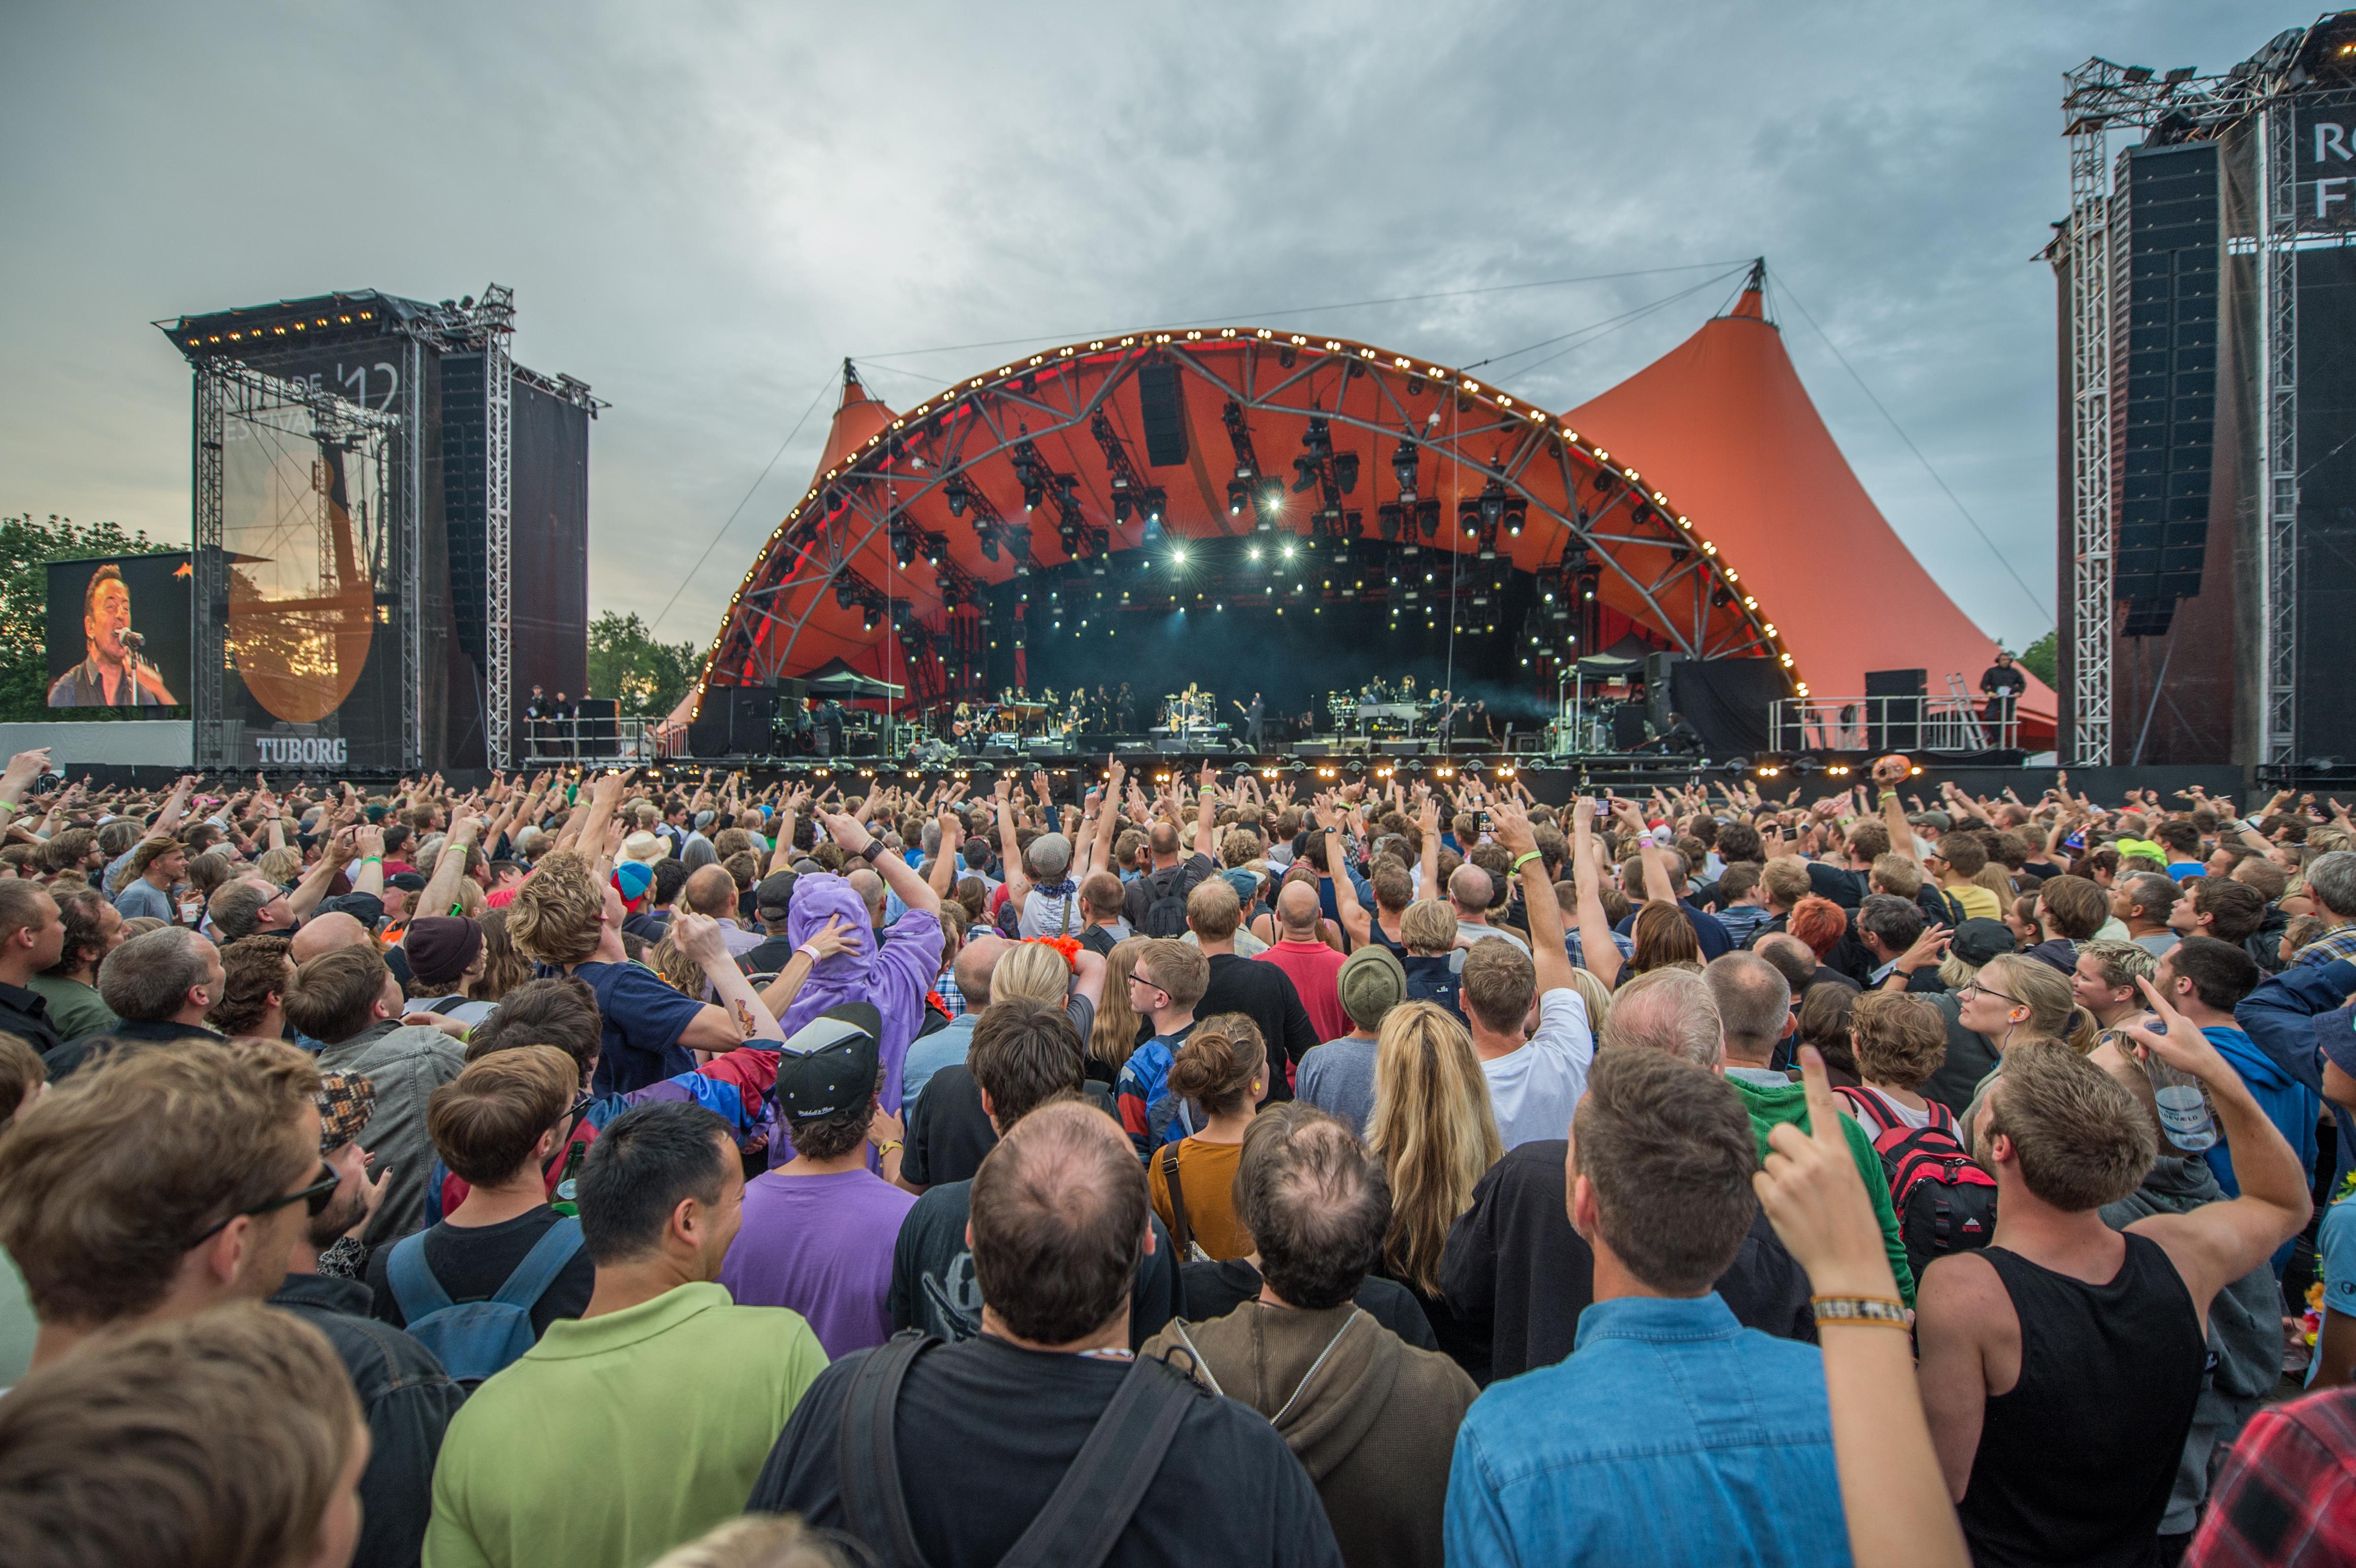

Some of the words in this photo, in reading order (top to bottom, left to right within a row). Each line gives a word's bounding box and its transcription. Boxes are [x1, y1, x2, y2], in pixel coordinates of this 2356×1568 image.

[2315, 122, 2356, 162] R
[2317, 177, 2356, 219] F
[256, 738, 347, 763] TUBORG
